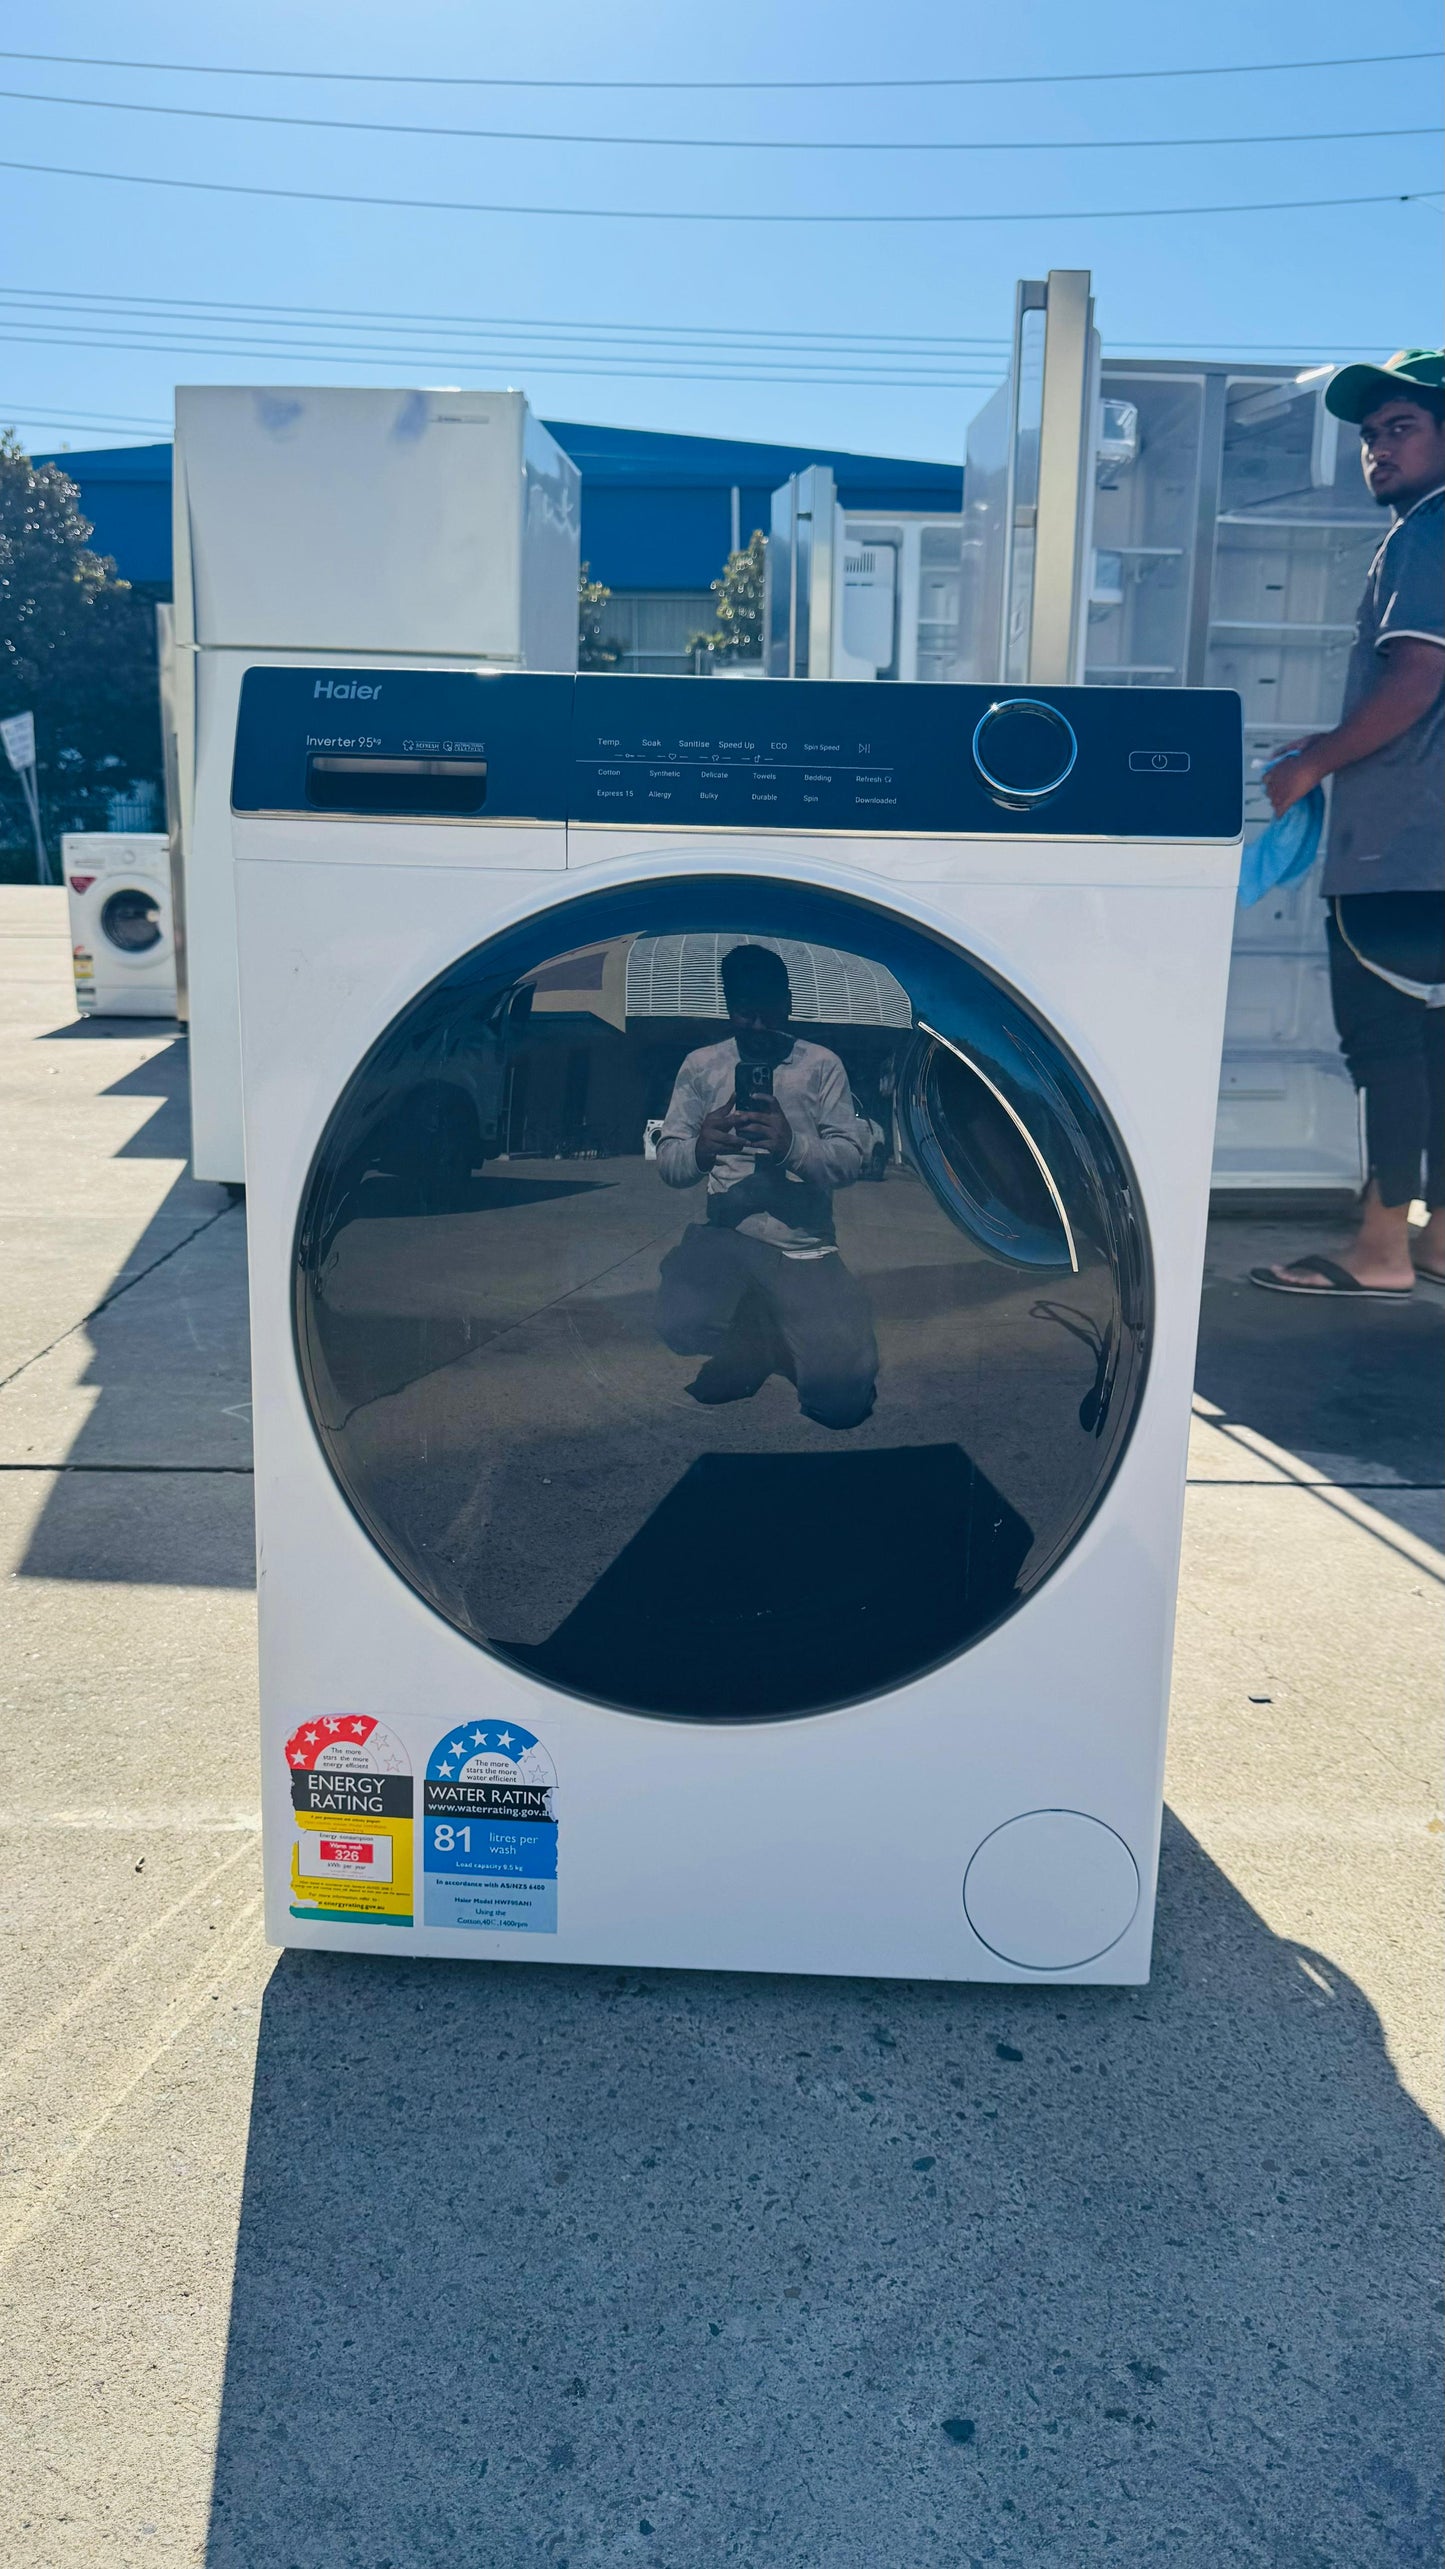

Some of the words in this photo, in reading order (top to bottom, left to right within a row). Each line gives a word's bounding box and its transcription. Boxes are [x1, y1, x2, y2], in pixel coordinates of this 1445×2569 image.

[313, 680, 382, 700] Haier
[306, 735, 356, 748] Inverter
[642, 739, 662, 747] Soak
[678, 740, 710, 748] Sanitise
[718, 741, 742, 750] Speed
[744, 742, 755, 750] Up
[770, 742, 788, 750] ECO
[820, 744, 840, 752] Speed
[650, 770, 680, 778] Synthetic
[753, 772, 776, 780] Towels
[804, 774, 832, 783] Bedding
[596, 790, 624, 798] Express
[648, 791, 672, 800] Allergy
[700, 792, 718, 801] Bulky
[803, 795, 818, 803] Spin
[855, 796, 897, 805] Downloaded
[323, 1762, 344, 1770] energy
[345, 1762, 369, 1770] efficient
[474, 1759, 489, 1767] The
[466, 1774, 486, 1782] water
[488, 1775, 517, 1784] efficient
[308, 1774, 386, 1794] ENERGY
[428, 1786, 486, 1803] WATER
[310, 1794, 384, 1813] RATING
[434, 1824, 472, 1853] 81
[490, 1832, 518, 1844] litres
[520, 1836, 538, 1847] per
[489, 1844, 516, 1855] wash
[334, 1850, 360, 1862] 326
[474, 1863, 502, 1871] capacity
[444, 1880, 482, 1888] accordance
[476, 1908, 494, 1917] Using
